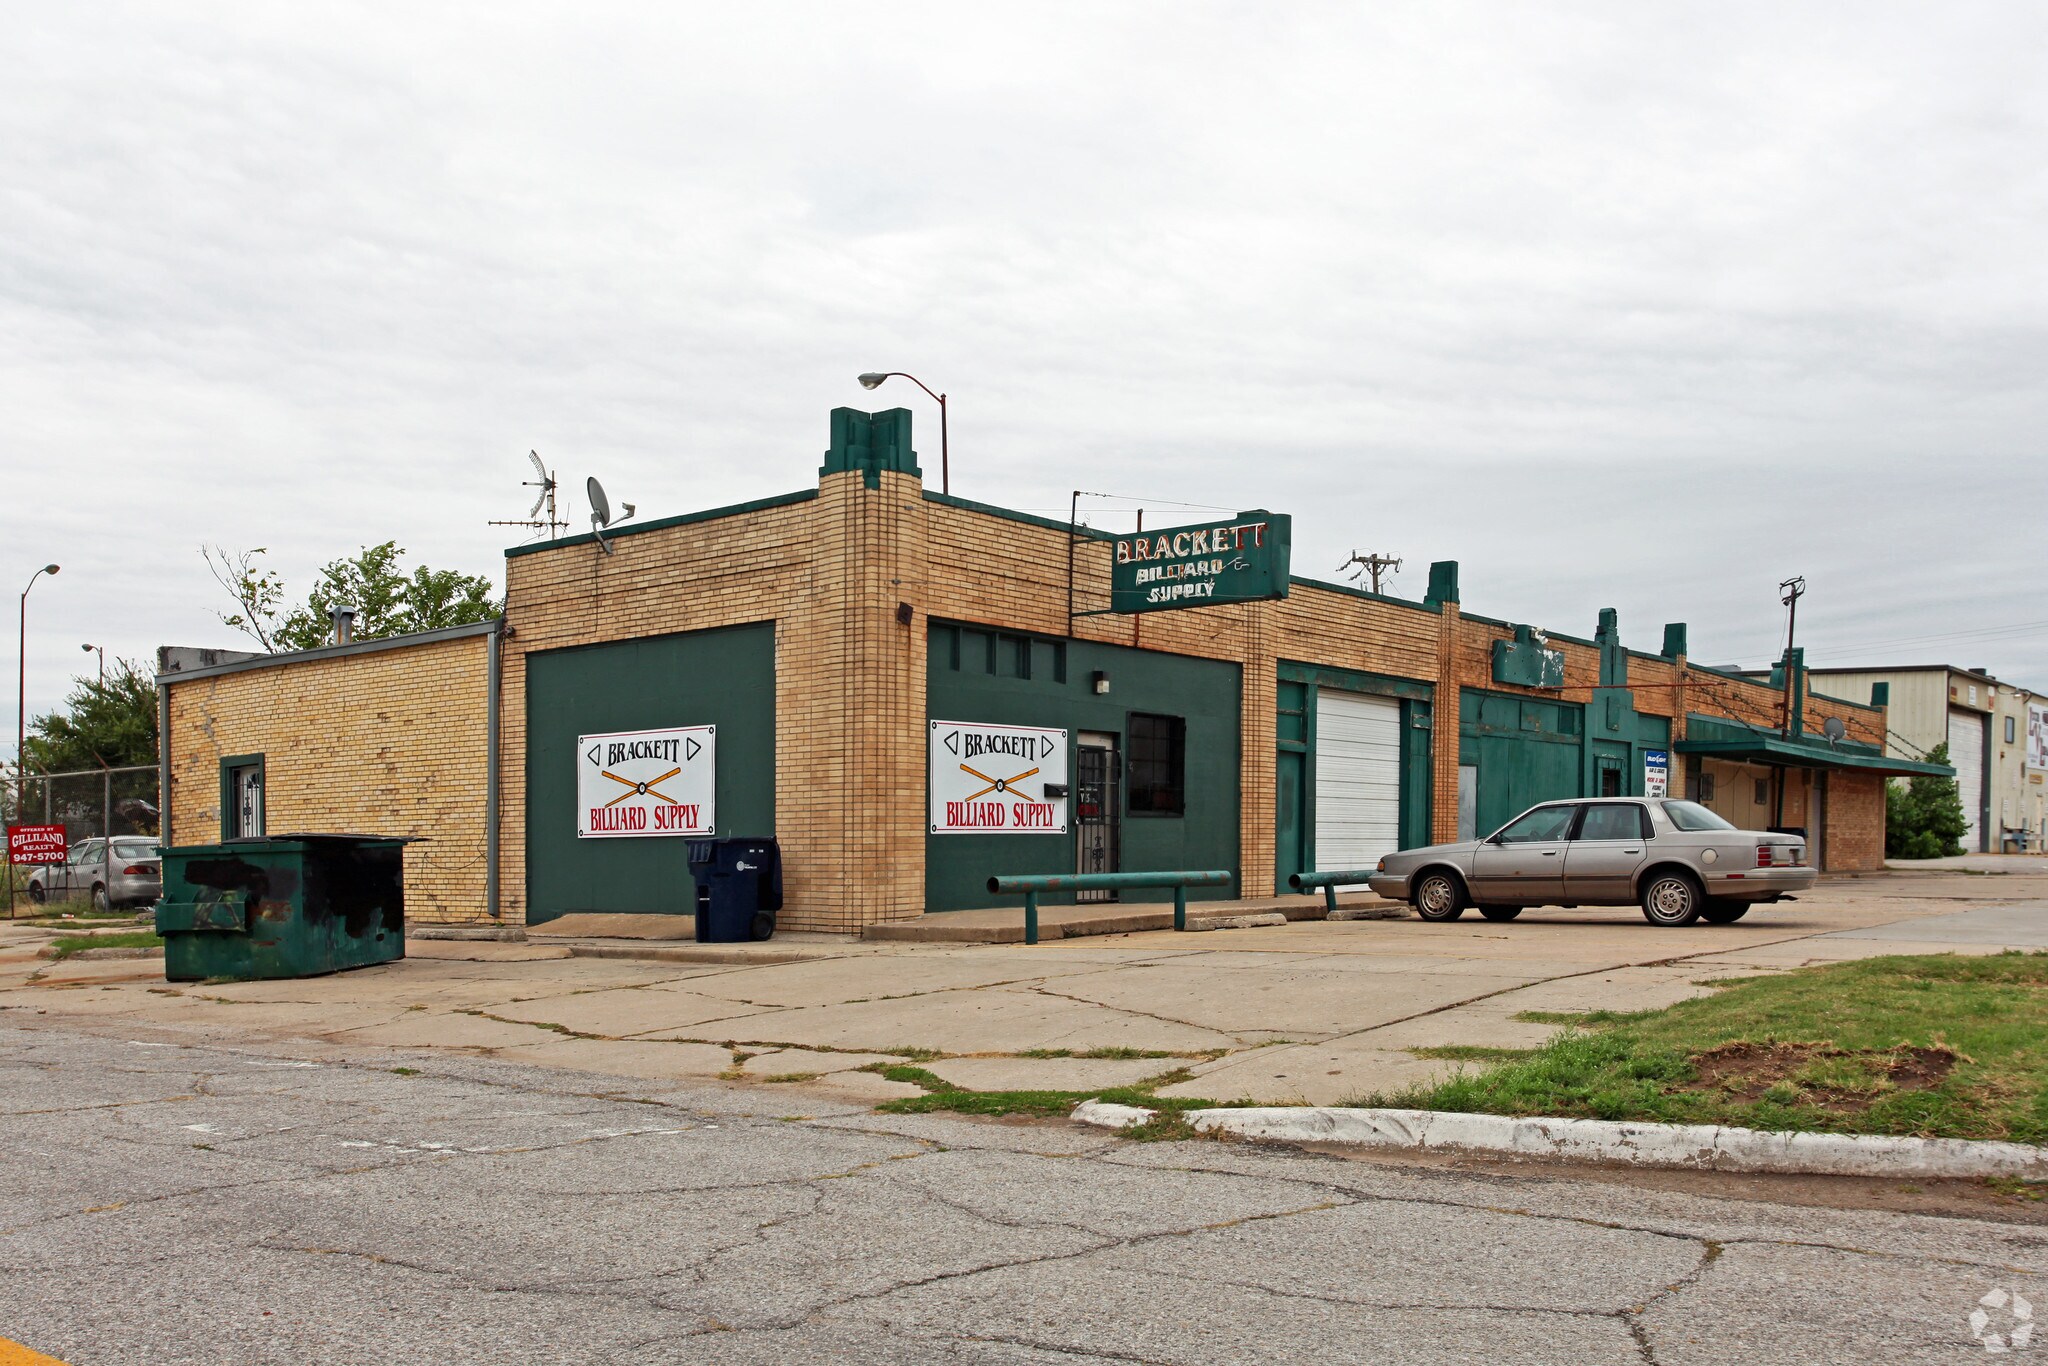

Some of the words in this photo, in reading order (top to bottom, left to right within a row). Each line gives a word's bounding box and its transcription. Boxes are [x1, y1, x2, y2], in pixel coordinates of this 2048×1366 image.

[1117, 522, 1268, 564] BRACKETT
[1146, 580, 1215, 603] SUPPLY
[607, 739, 680, 767] BRACKETT
[964, 733, 1036, 761] BRACKETT
[590, 806, 646, 831] BILLIARD
[654, 804, 700, 830] SUPPLY
[946, 801, 1005, 827] BILLIARD
[1012, 802, 1055, 827] SUPPLY
[12, 833, 64, 847] GILLILAND
[13, 852, 64, 862] 947-5700
